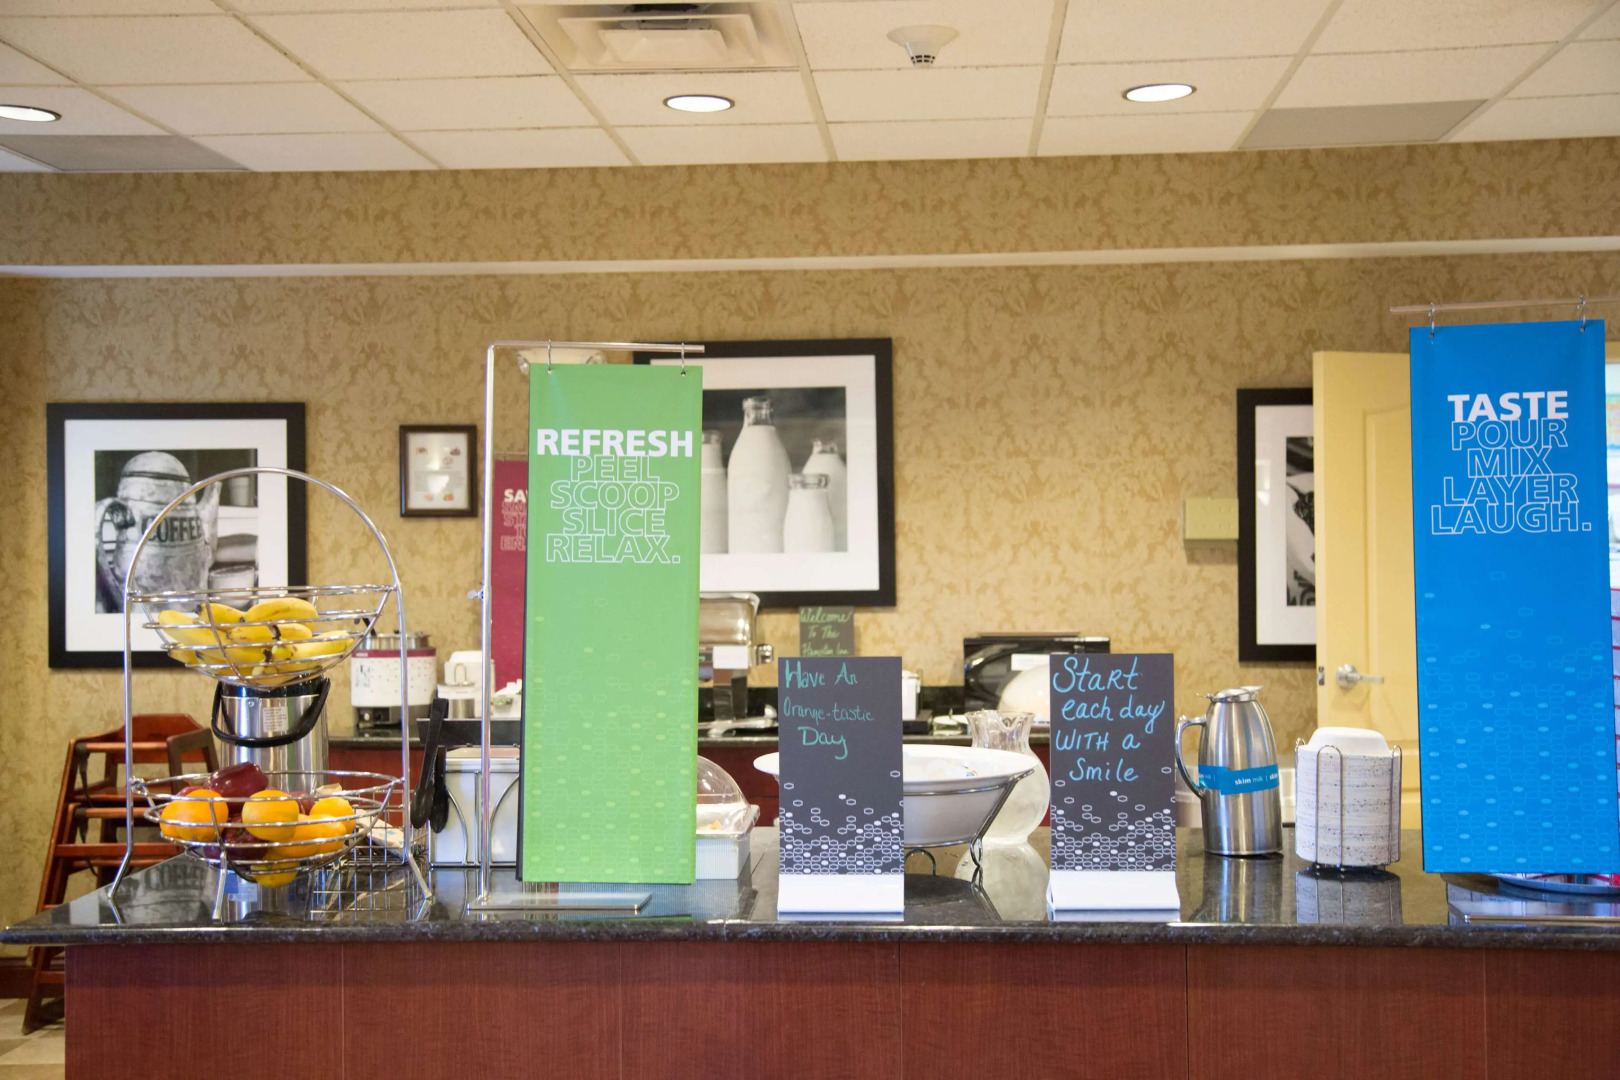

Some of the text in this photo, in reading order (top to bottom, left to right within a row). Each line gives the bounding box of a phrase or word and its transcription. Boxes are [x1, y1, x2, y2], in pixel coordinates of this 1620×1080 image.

[1447, 391, 1569, 422] TASTE
[537, 429, 693, 457] REFRESH
[1452, 418, 1568, 451] POUR
[570, 454, 660, 483] PEEL
[1467, 446, 1553, 478] MIX
[504, 488, 528, 503] SA
[550, 480, 680, 510] SCOOP
[1443, 473, 1579, 507] LAYER
[562, 507, 666, 537] SLICE
[1431, 501, 1592, 535] LAUGH.
[546, 533, 681, 564] RELAX.
[799, 606, 854, 623] Welcome
[821, 625, 840, 639] The
[785, 659, 858, 689] Have An
[1061, 694, 1166, 734] each day
[797, 726, 848, 760] Day
[1055, 729, 1141, 752] WITH a
[1069, 757, 1138, 783] Smile
[1235, 777, 1251, 786] skim
